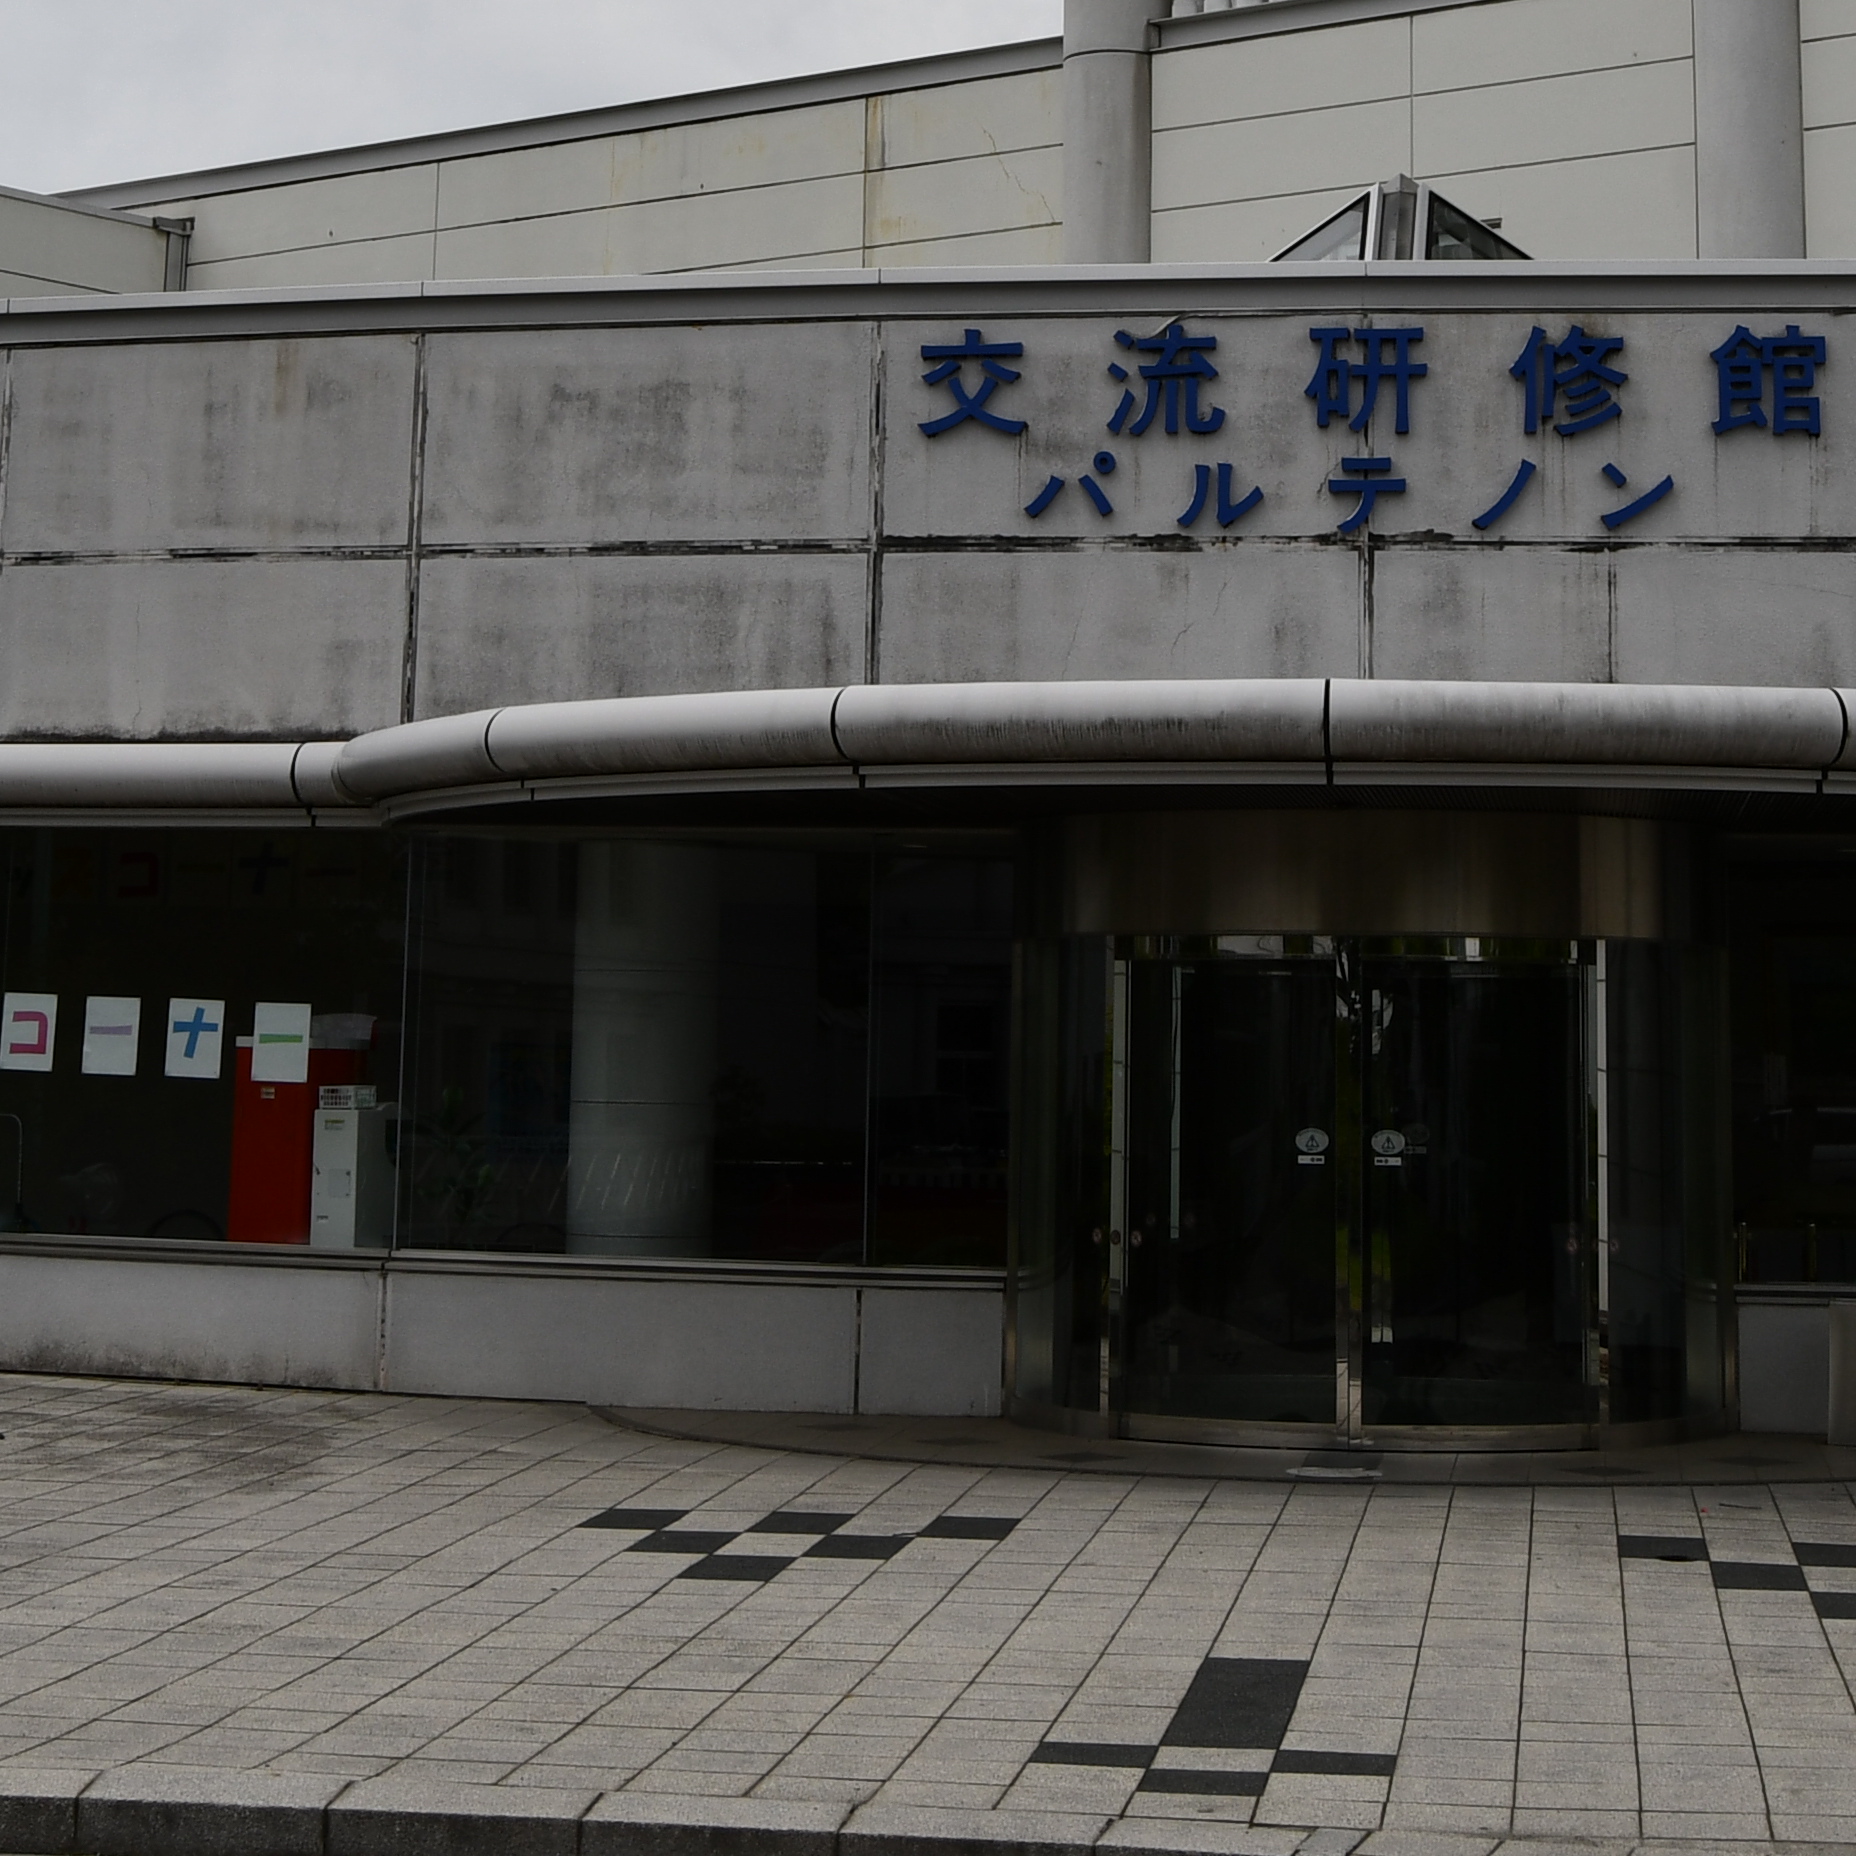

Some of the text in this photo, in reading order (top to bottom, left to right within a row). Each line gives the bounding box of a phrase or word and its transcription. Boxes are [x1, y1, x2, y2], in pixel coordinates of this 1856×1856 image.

[918, 324, 1827, 436] 交流研修館
[1023, 450, 1674, 533] パルテノン
